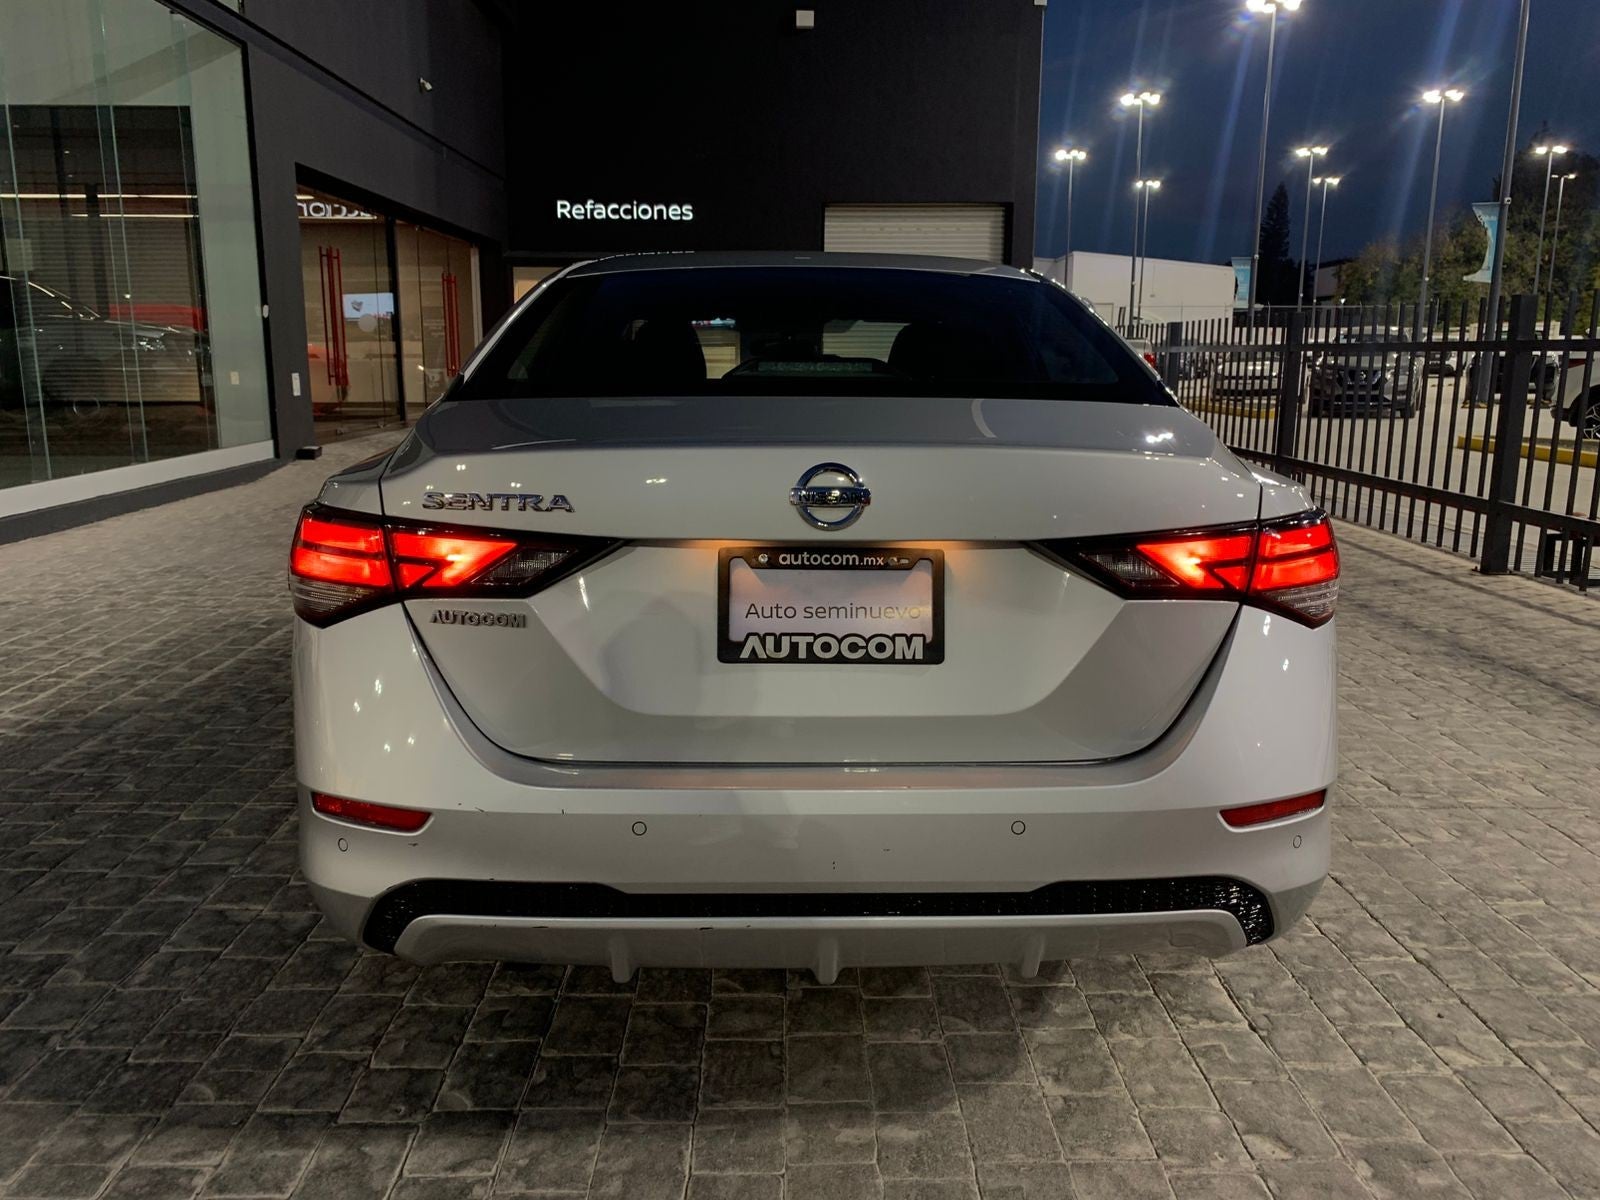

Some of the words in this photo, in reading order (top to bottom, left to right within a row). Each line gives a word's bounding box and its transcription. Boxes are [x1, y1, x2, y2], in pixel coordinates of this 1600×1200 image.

[556, 199, 694, 220] Refacciones
[422, 491, 575, 513] SENTRA
[778, 552, 884, 566] autocom.mx
[430, 609, 527, 629] AUTOCOM
[745, 603, 797, 619] Auto
[803, 602, 921, 619] seminuevo
[739, 634, 924, 660] AUTOCOM
